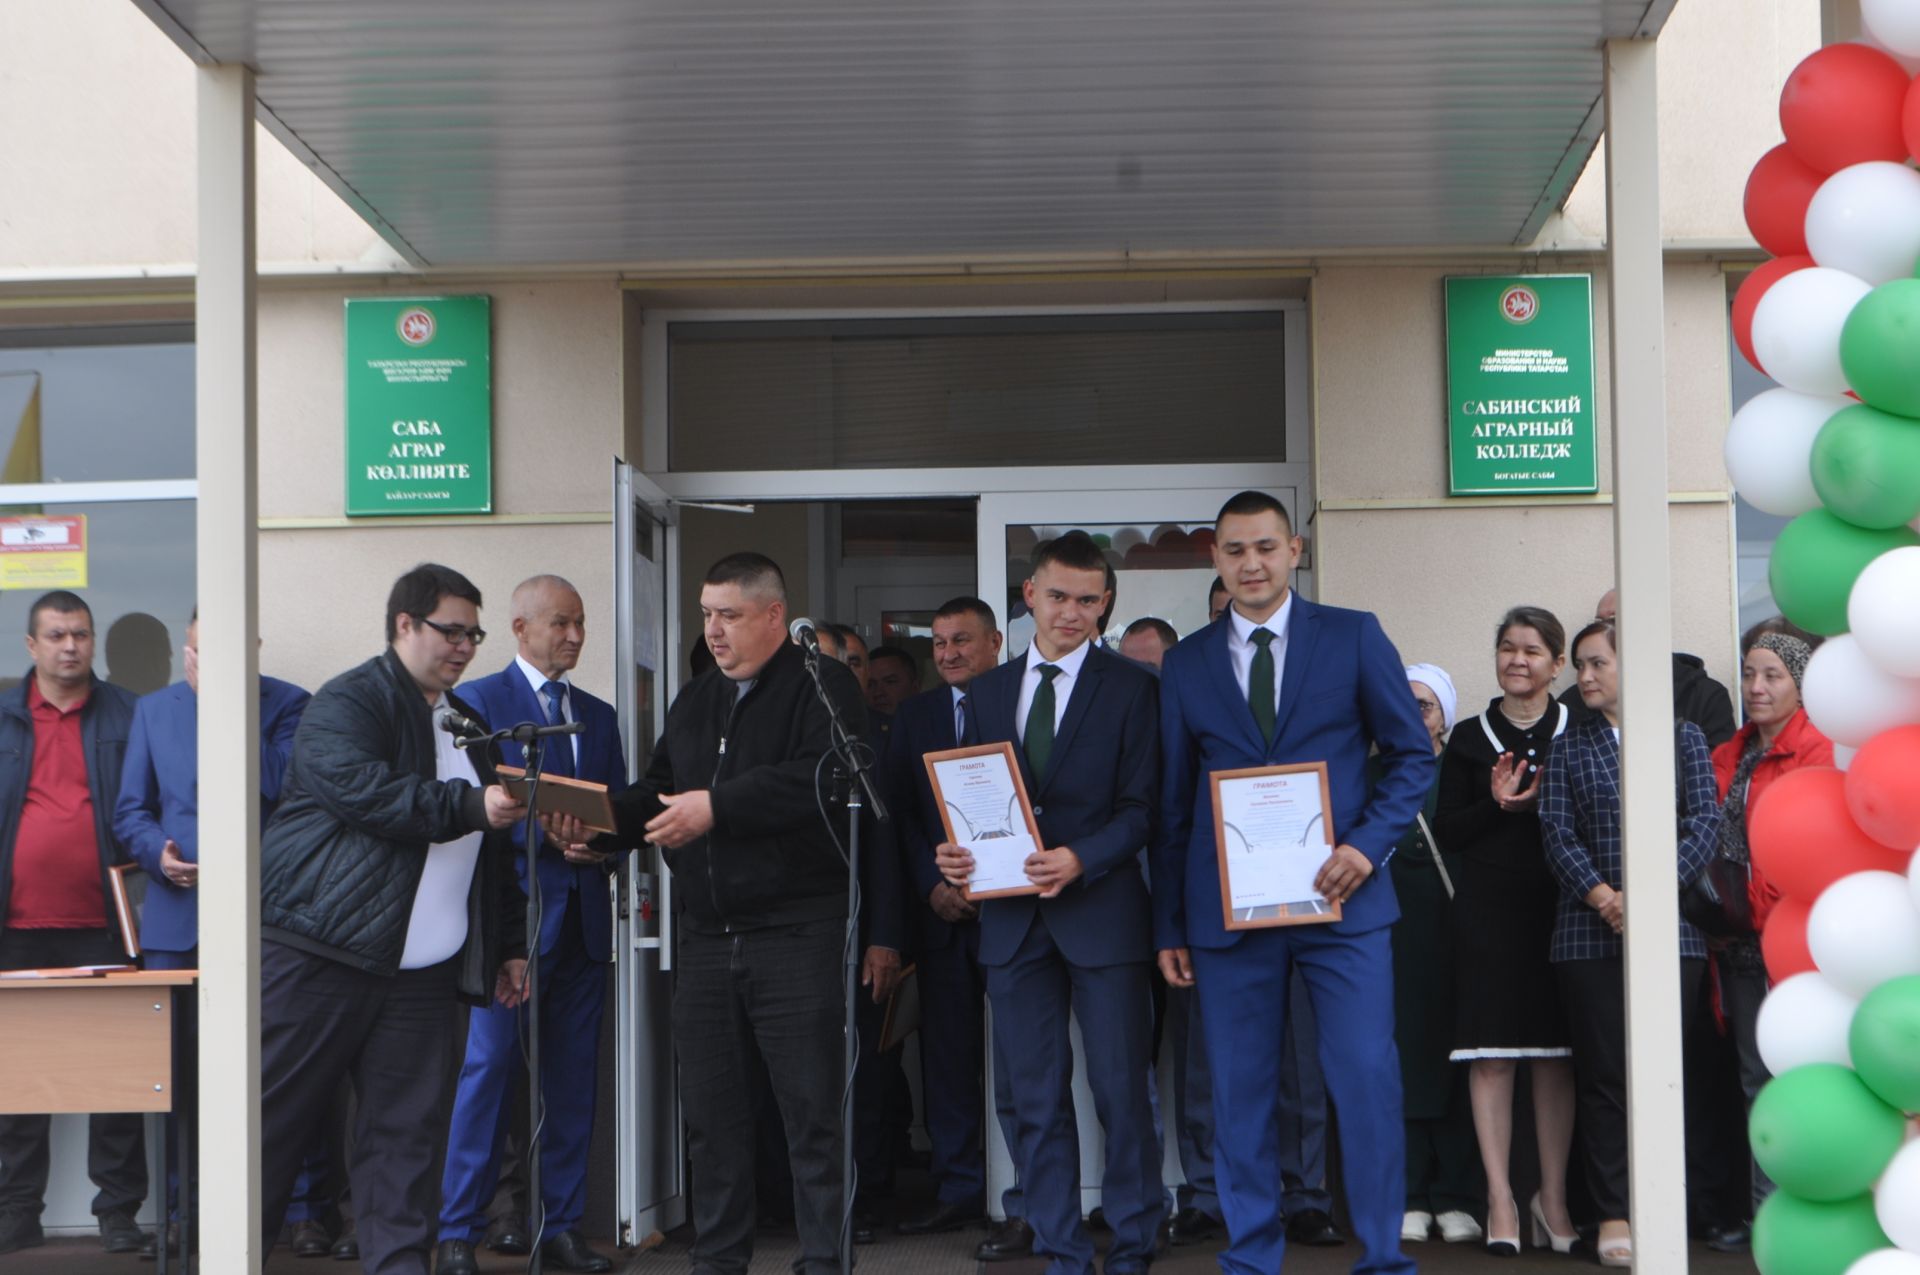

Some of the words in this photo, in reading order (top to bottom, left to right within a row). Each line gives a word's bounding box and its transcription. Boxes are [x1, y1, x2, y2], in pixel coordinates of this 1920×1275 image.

[1495, 349, 1553, 358] МИНИСТЕРСТВО
[1543, 357, 1567, 365] НАУКИ
[1480, 365, 1528, 373] РЕСПУБЛИКИ
[1528, 365, 1568, 373] ТАТАРСТАН
[1462, 396, 1581, 416] САБИНСКИЙ
[391, 420, 442, 436] САБА
[1471, 418, 1574, 438] АГРАРНЫЙ
[388, 442, 445, 458] АГРАР
[1476, 443, 1571, 460] КОЛЛЕДЖ
[366, 464, 470, 480] КӨЛЛИЯТЕ
[1494, 472, 1530, 480] БОГАТЫЕ
[1531, 471, 1555, 479] САБЫ
[959, 761, 985, 771] ГРАМОТА
[1253, 780, 1287, 790] ГРАМОТА
